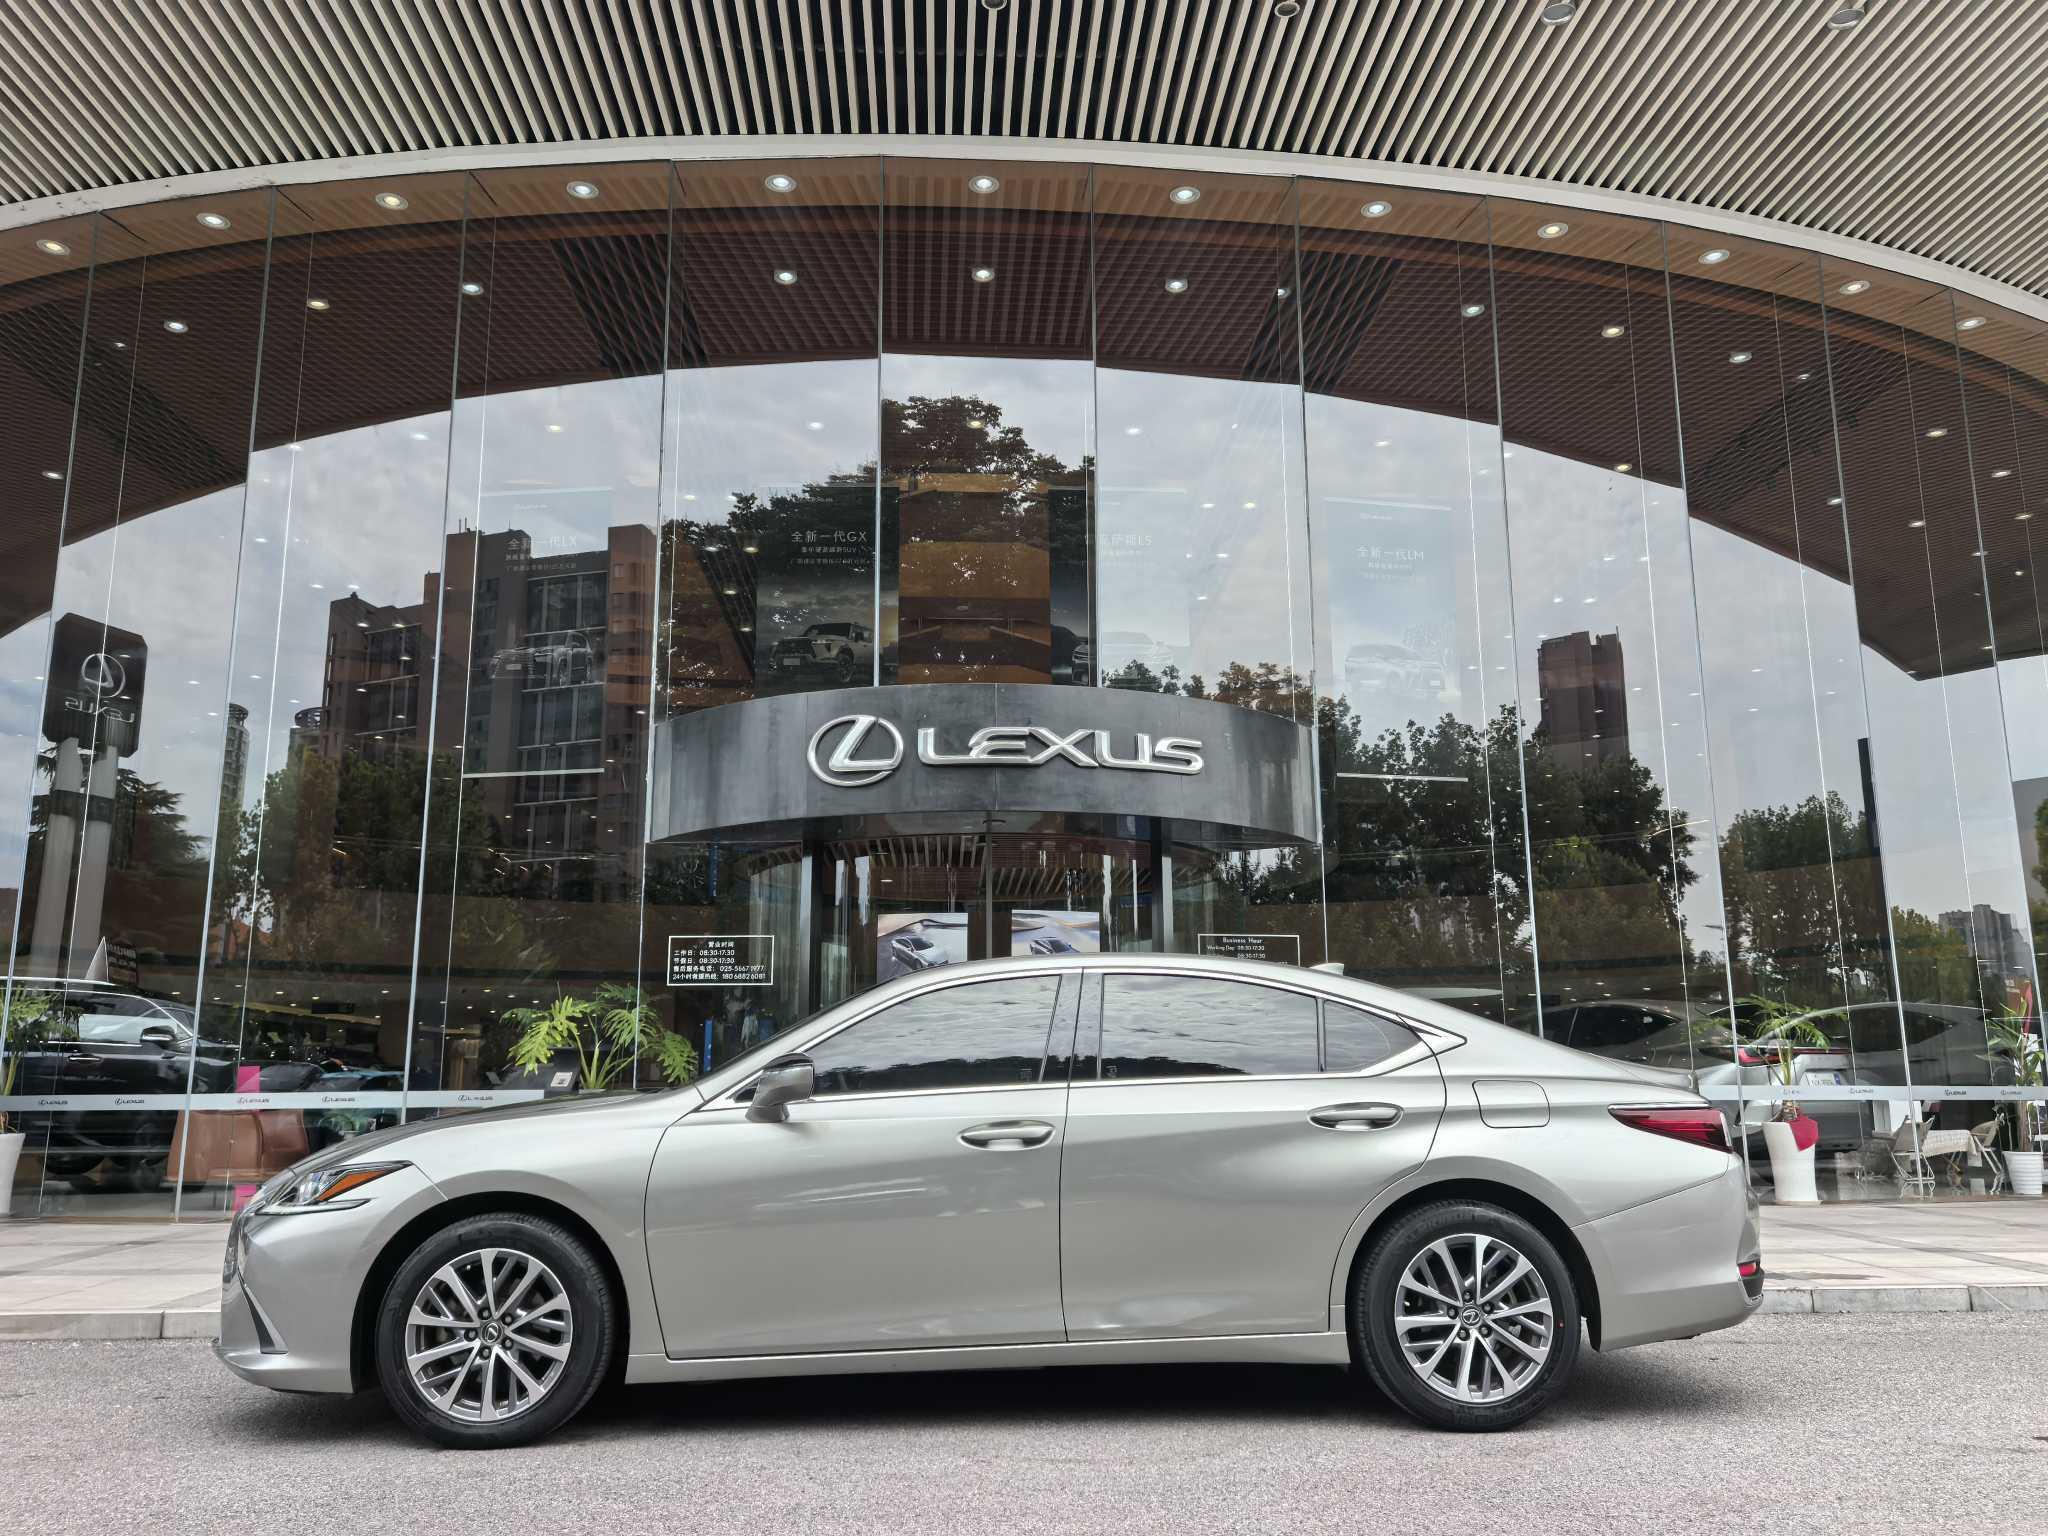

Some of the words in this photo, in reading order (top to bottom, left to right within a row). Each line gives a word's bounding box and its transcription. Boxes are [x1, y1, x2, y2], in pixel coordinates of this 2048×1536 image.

[791, 531, 867, 543] 全新一代GX
[917, 726, 1203, 775] LEXUS
